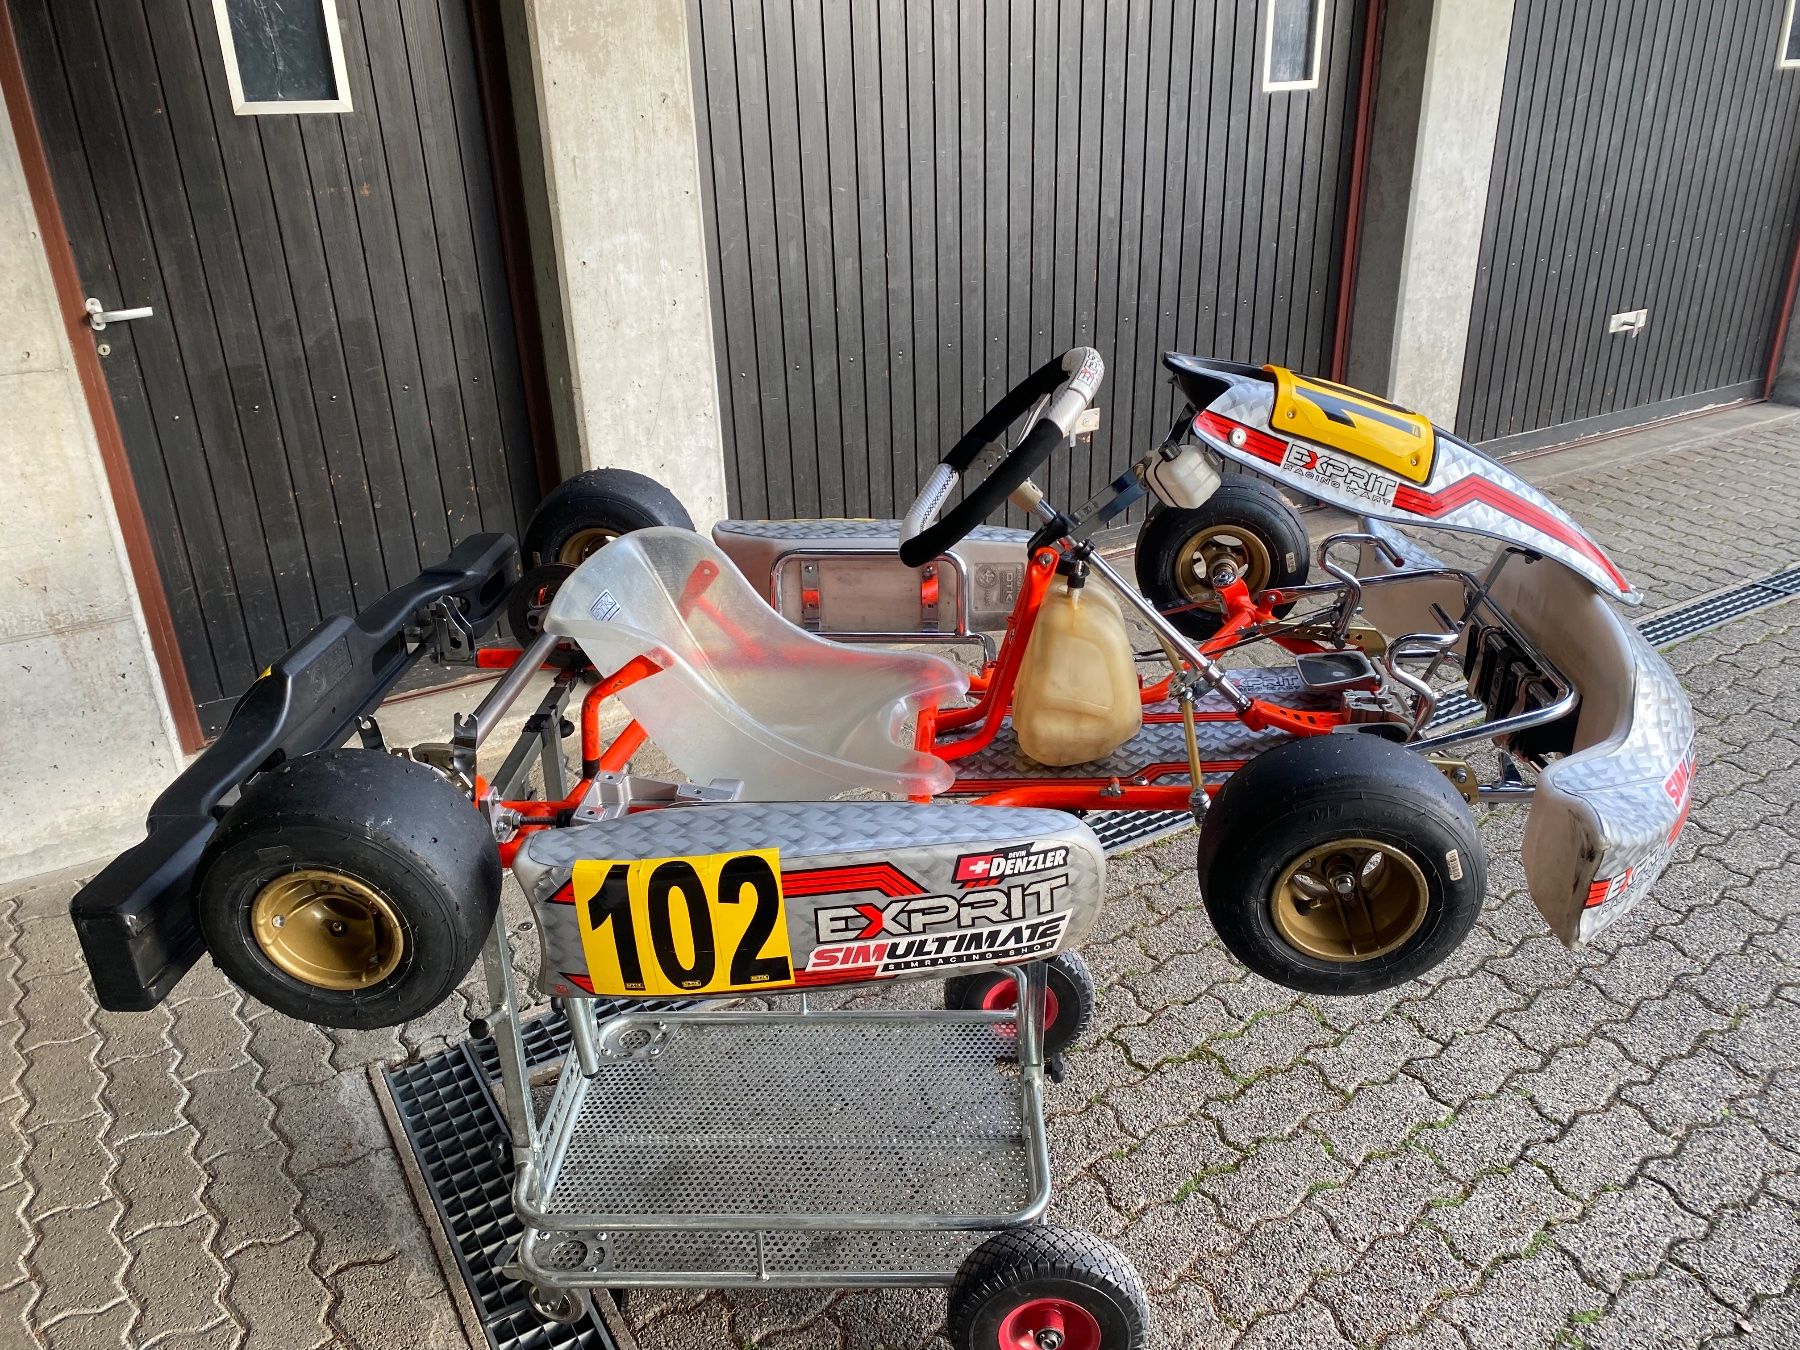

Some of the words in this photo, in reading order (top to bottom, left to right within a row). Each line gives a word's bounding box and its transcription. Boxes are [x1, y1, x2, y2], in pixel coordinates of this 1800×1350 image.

[1284, 463, 1340, 488] RACING
[1346, 486, 1391, 505] KART
[1287, 444, 1397, 496] EXPRIT
[1232, 674, 1298, 688] XPRIT
[988, 849, 1066, 877] DENZLER
[1008, 849, 1027, 859] DEVIN
[587, 855, 792, 991] 102
[814, 873, 1068, 944] EXPRIT
